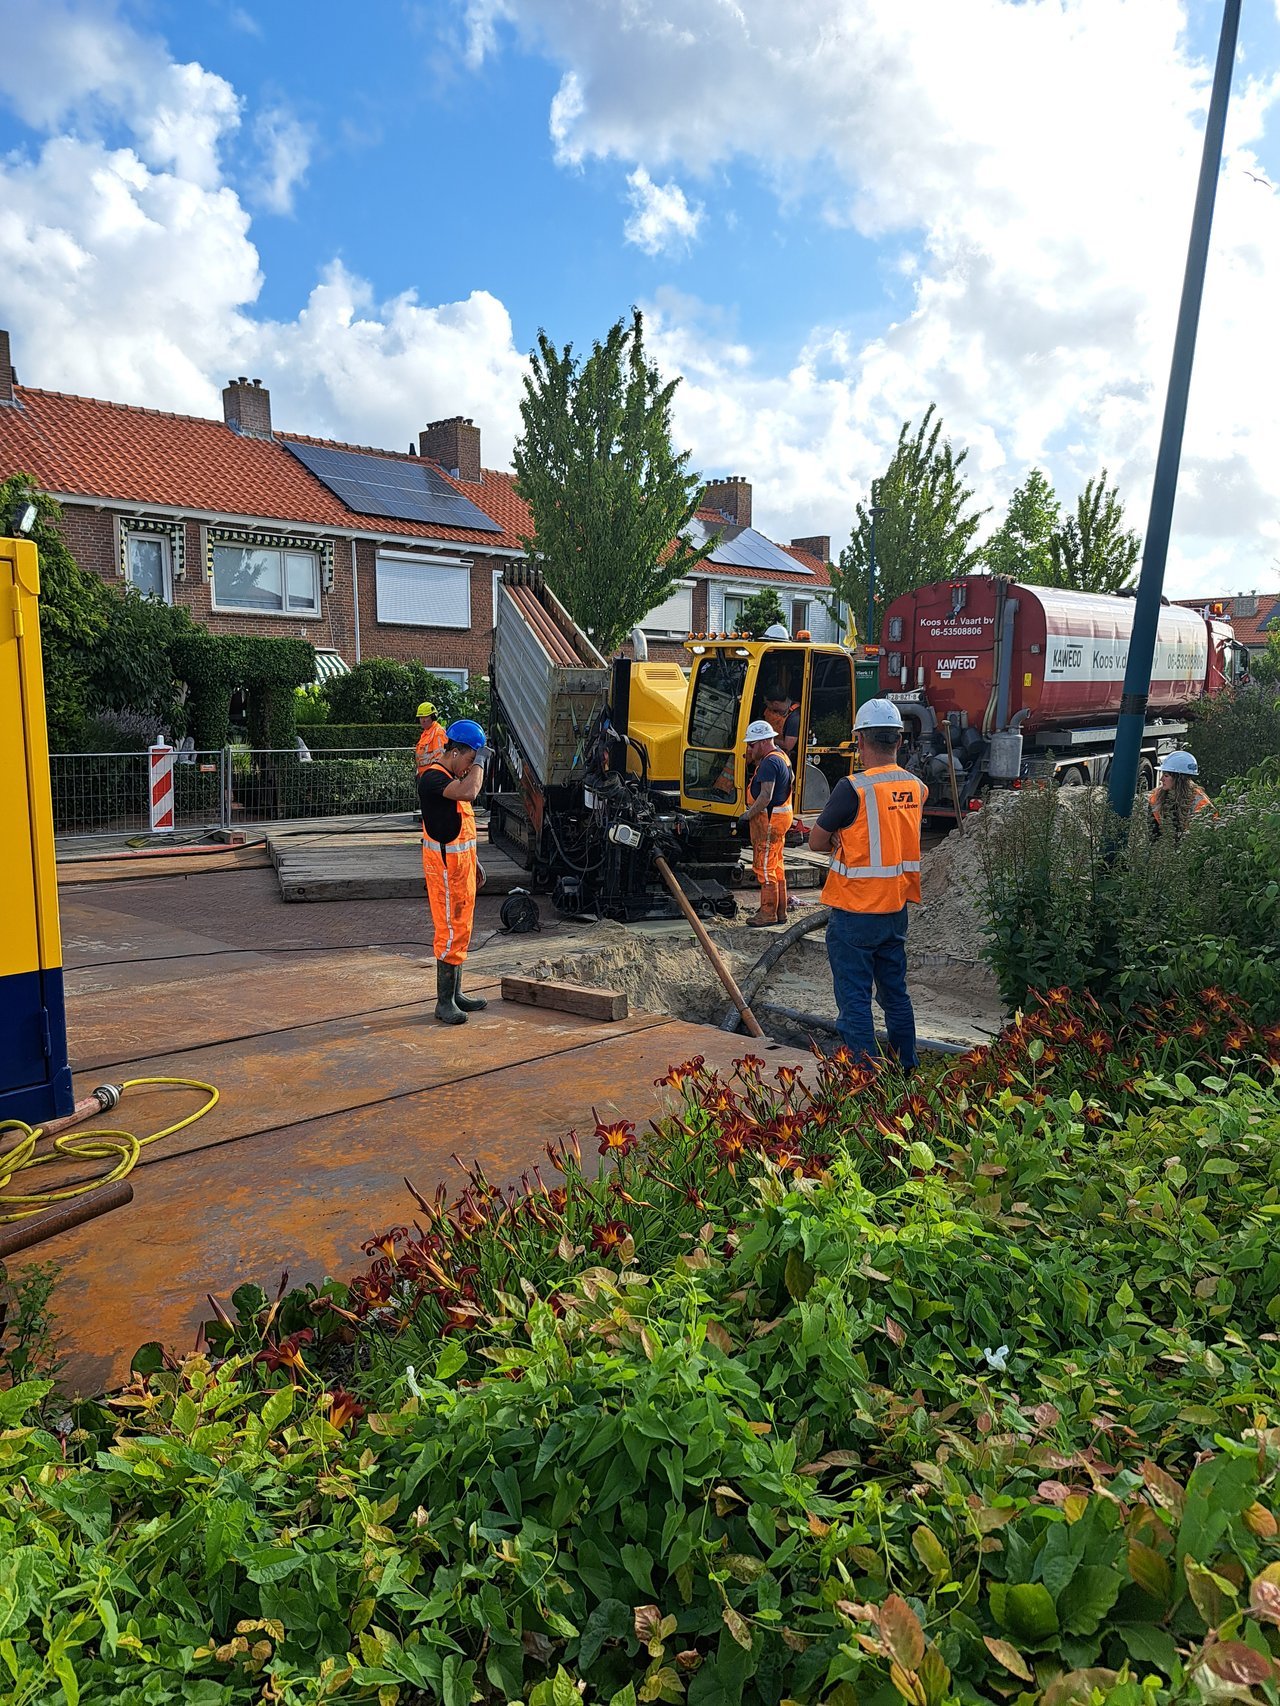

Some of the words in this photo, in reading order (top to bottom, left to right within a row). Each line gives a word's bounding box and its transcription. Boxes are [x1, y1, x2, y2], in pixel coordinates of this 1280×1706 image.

[943, 618, 958, 626] v.d.
[960, 617, 981, 625] Vaart
[931, 627, 982, 636] 06-53508806
[1053, 649, 1082, 667] KAWECO
[1092, 651, 1113, 669] Koos
[937, 659, 976, 670] KAWECO
